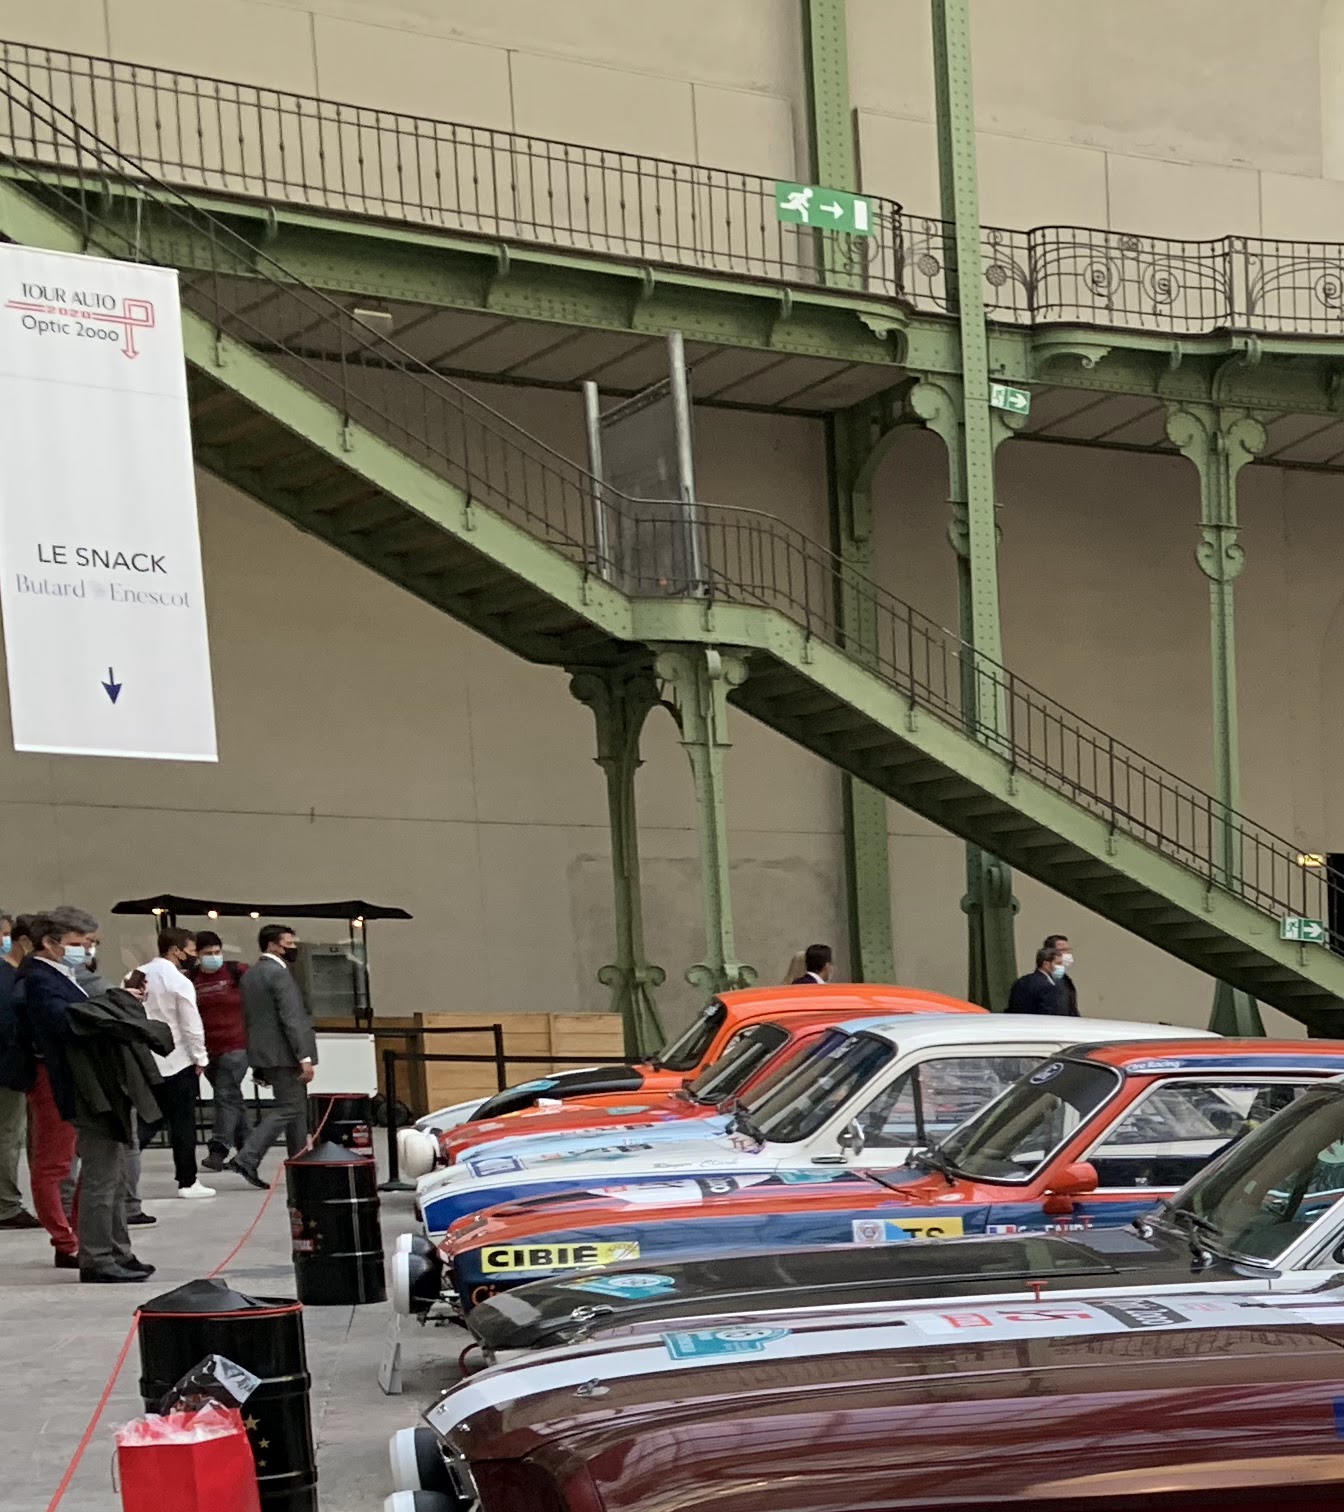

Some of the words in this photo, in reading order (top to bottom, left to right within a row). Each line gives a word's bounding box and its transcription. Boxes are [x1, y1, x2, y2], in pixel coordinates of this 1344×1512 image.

[21, 283, 66, 303] TOUR
[72, 290, 116, 310] AUTO
[45, 305, 93, 320] 2020
[22, 315, 70, 336] Optic
[76, 322, 119, 341] 2000
[38, 543, 68, 565] LE
[75, 547, 168, 574] SNACK
[16, 573, 86, 598] Butard
[110, 583, 190, 608] Enescot
[487, 1246, 600, 1268] CIBIÉ
